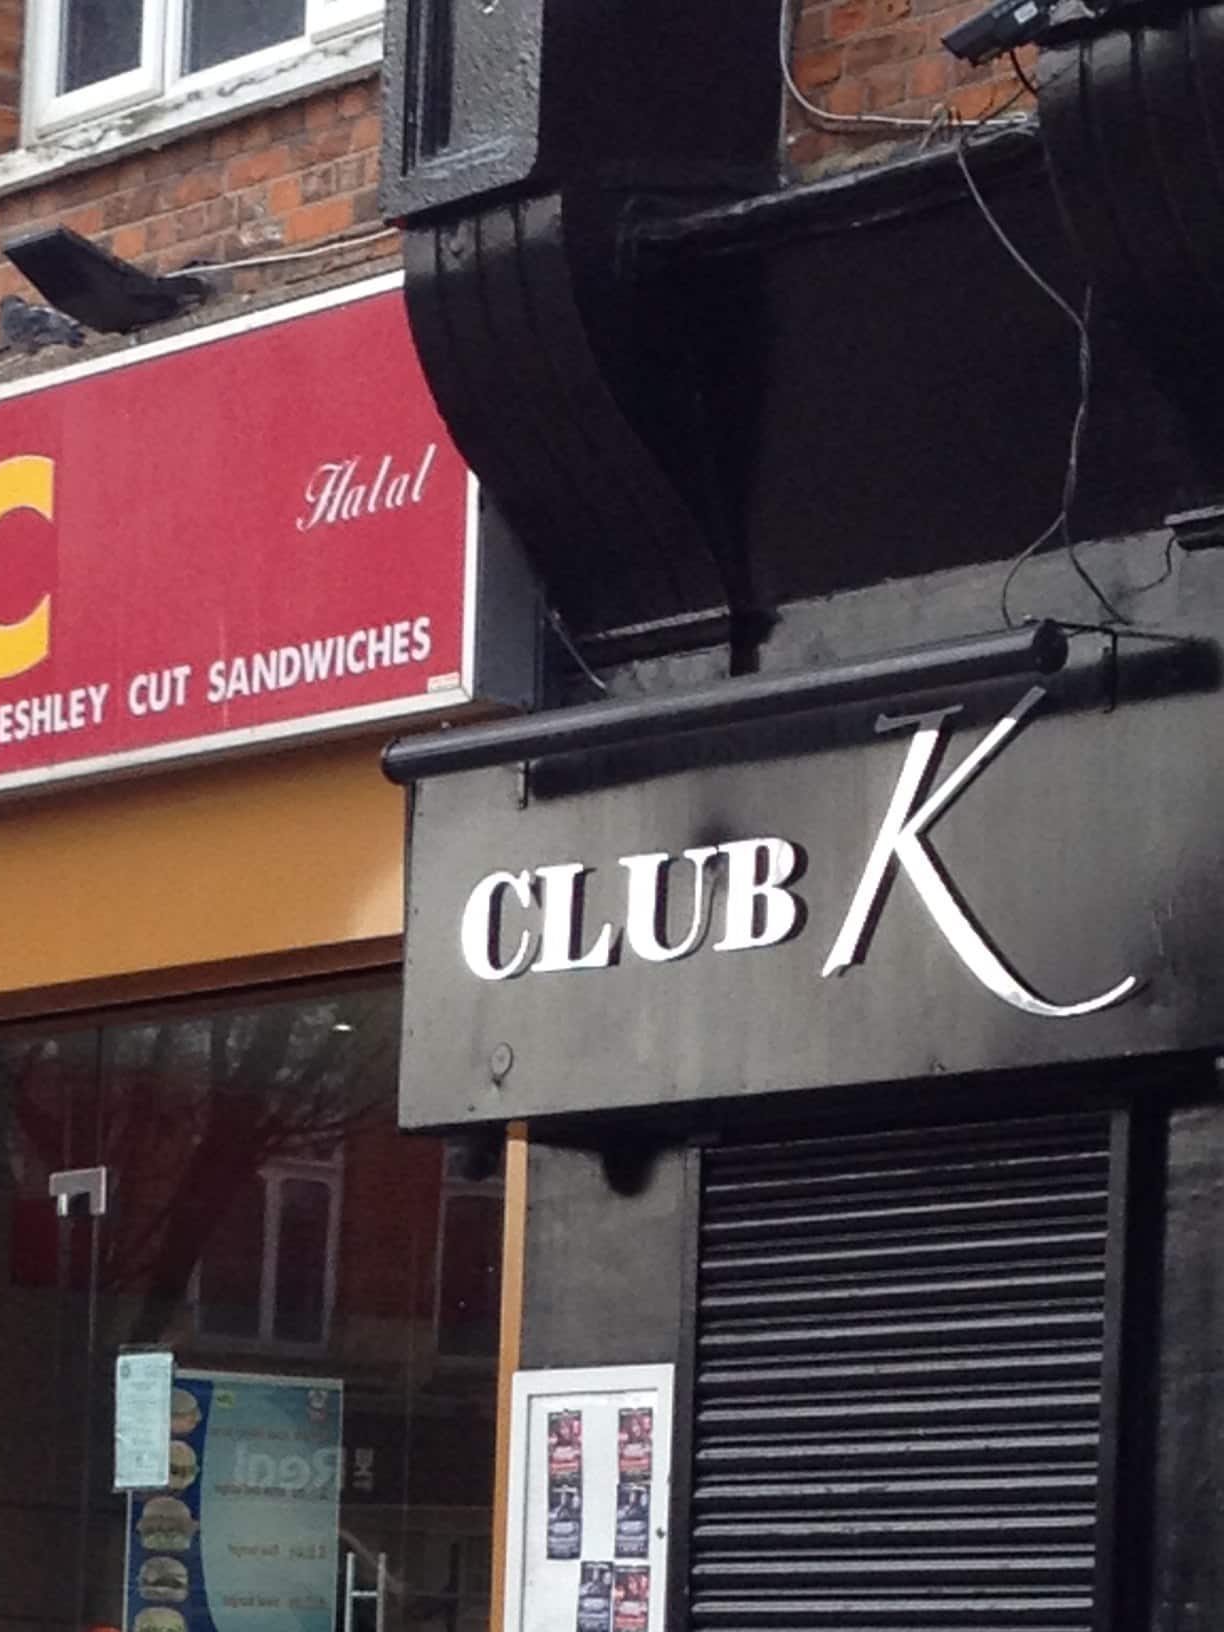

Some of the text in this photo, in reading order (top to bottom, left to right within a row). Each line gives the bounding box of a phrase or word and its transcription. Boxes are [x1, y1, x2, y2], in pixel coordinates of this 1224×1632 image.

[296, 443, 437, 533] Halal
[128, 666, 191, 715] CUT
[207, 616, 432, 702] SANDWICHES
[461, 686, 1137, 1017] CLUB K
